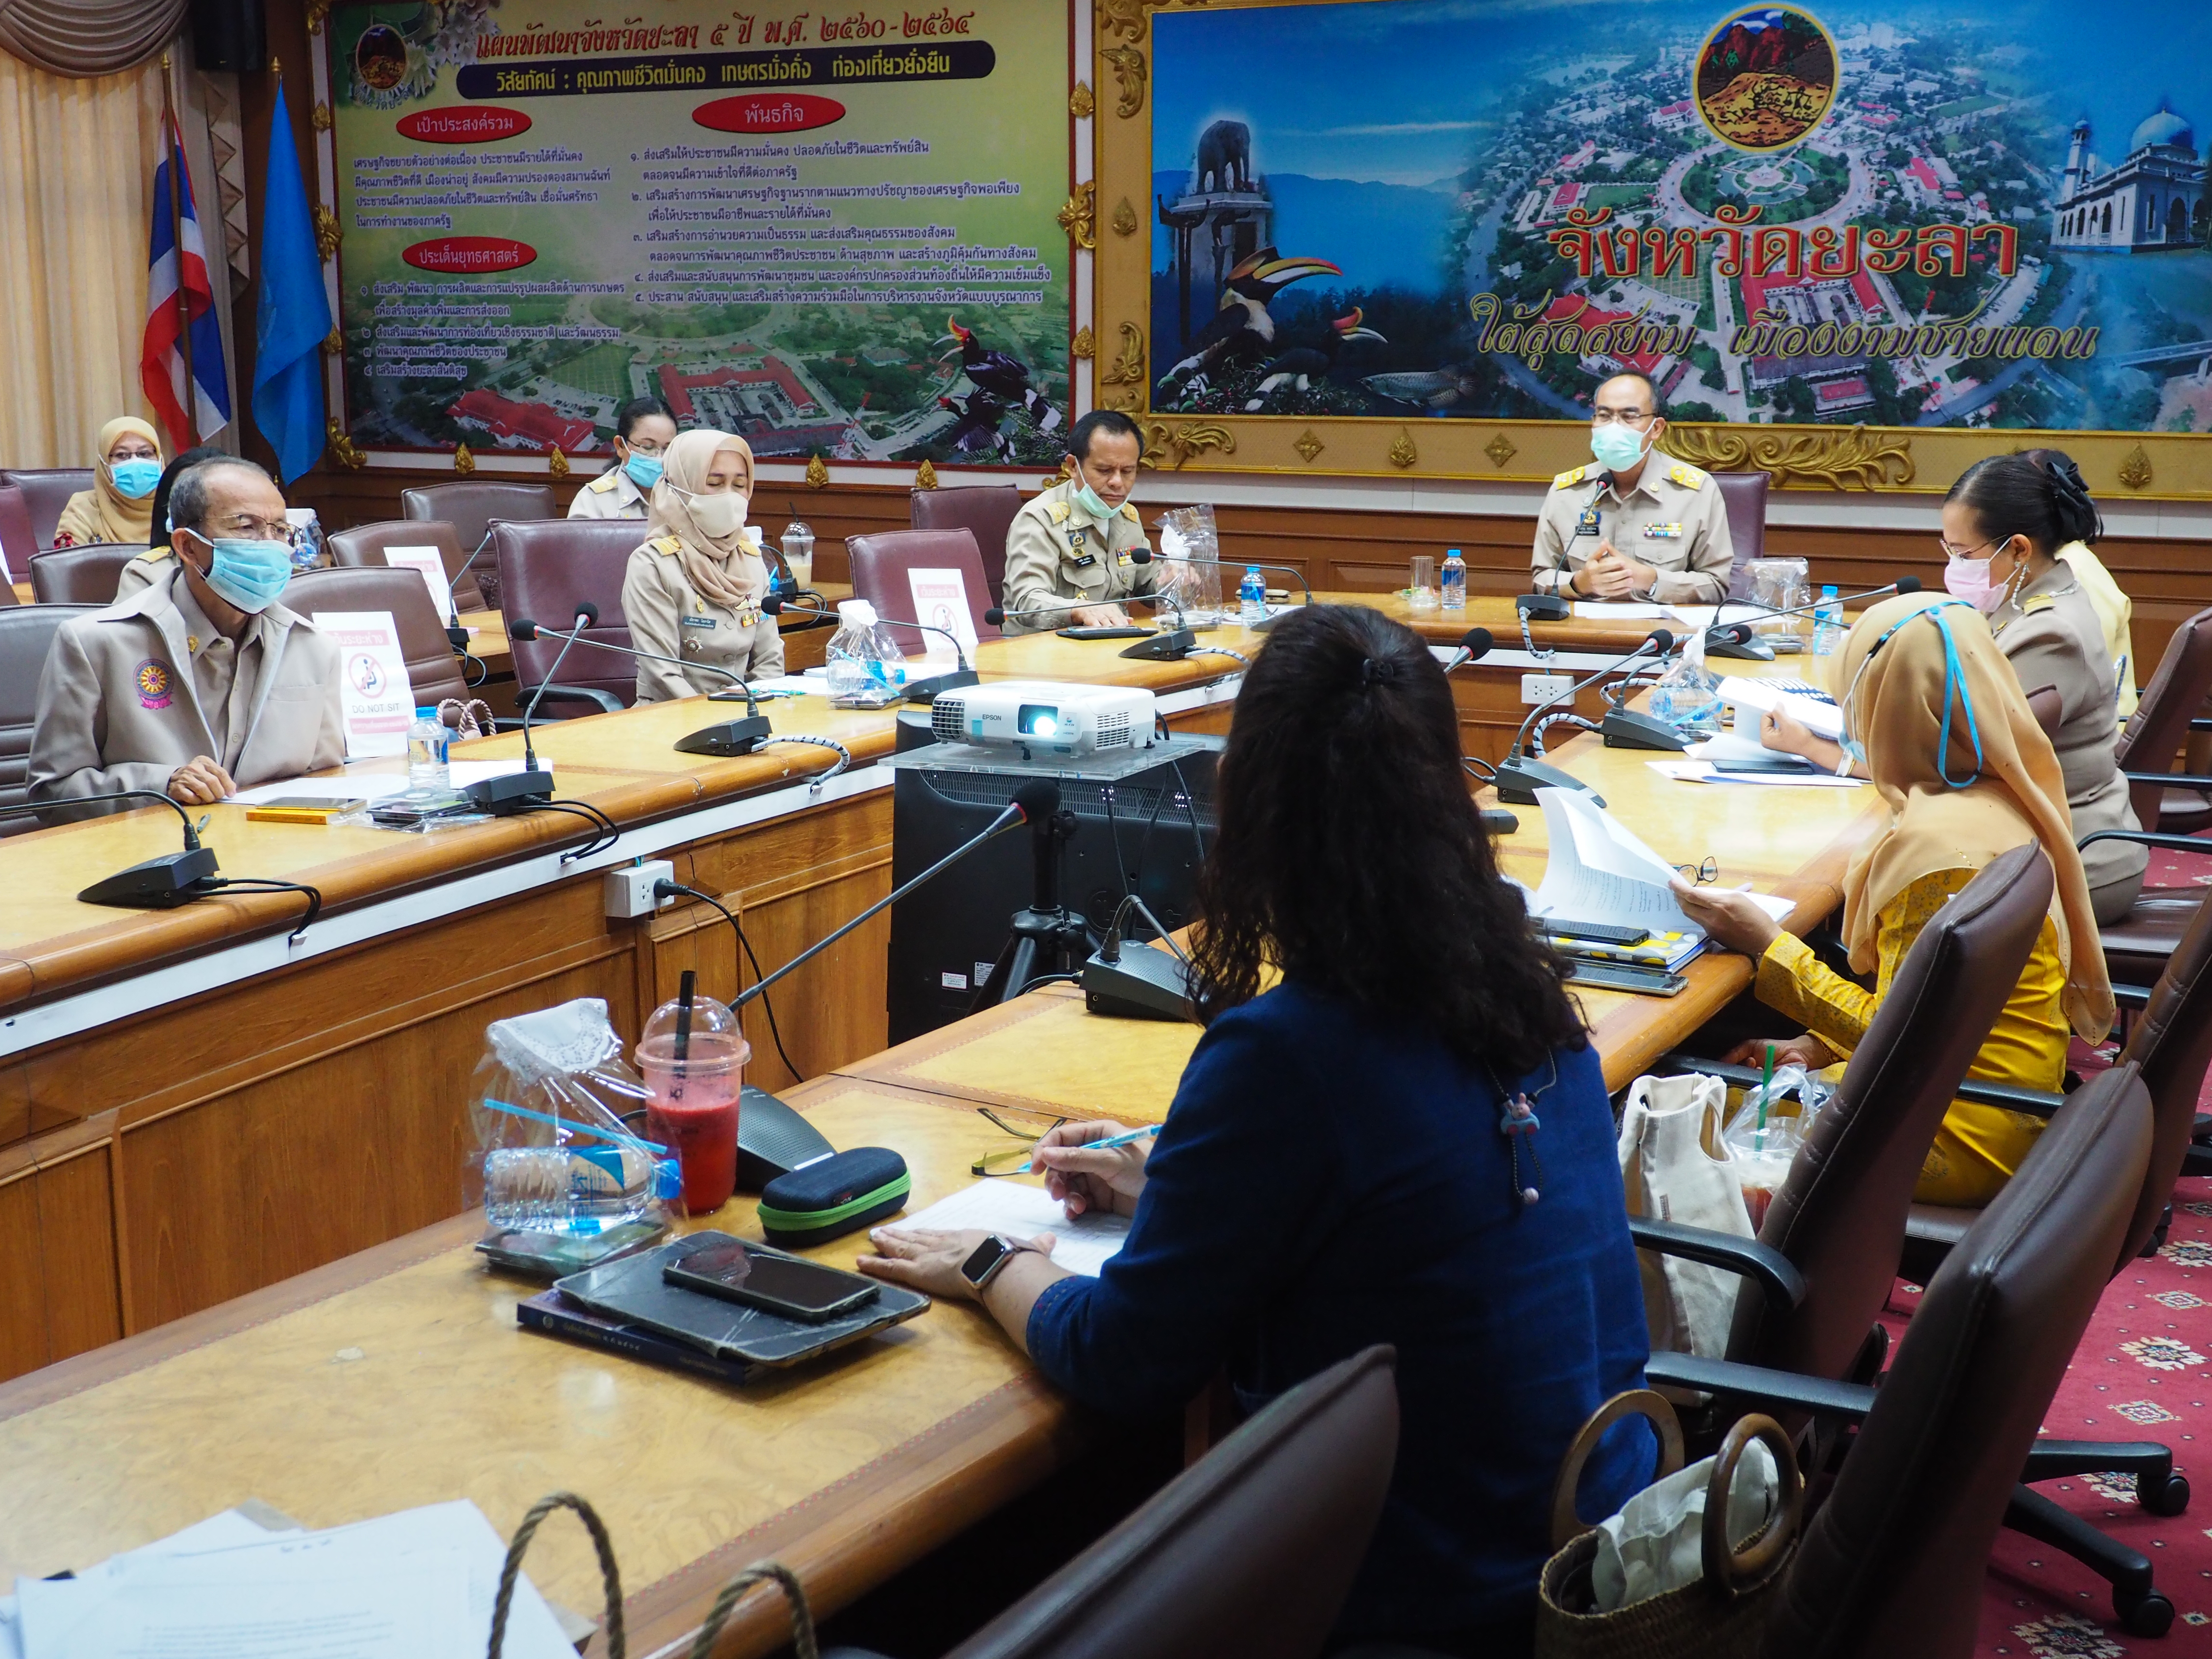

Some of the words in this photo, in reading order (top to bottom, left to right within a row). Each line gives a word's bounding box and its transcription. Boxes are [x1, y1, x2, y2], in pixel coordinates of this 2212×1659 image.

[475, 17, 700, 60] แผนพัฒนาจังหวัดยะลา
[733, 12, 756, 44] ปี
[497, 69, 555, 92] วิสัยทัศน์
[577, 59, 706, 95] คุณภาพชีวิตมั่นคง
[721, 54, 812, 82] เกษตรมั่งคั่ง
[832, 48, 950, 77] ท่องเที่ยวยั่งยืน
[417, 112, 514, 133] เป้าประสงค์รวม
[745, 101, 804, 124] พันธกิจ
[419, 244, 519, 268] ประเด็นยุทธศาสตร์
[1548, 204, 2019, 278] จังหวัดยะลา
[1468, 286, 1697, 369] ใต้สุดสยาม
[1728, 299, 2101, 360] เมืองงามชายแดน
[352, 705, 364, 713] DO
[368, 704, 385, 712] NOT
[388, 703, 400, 711] SIT
